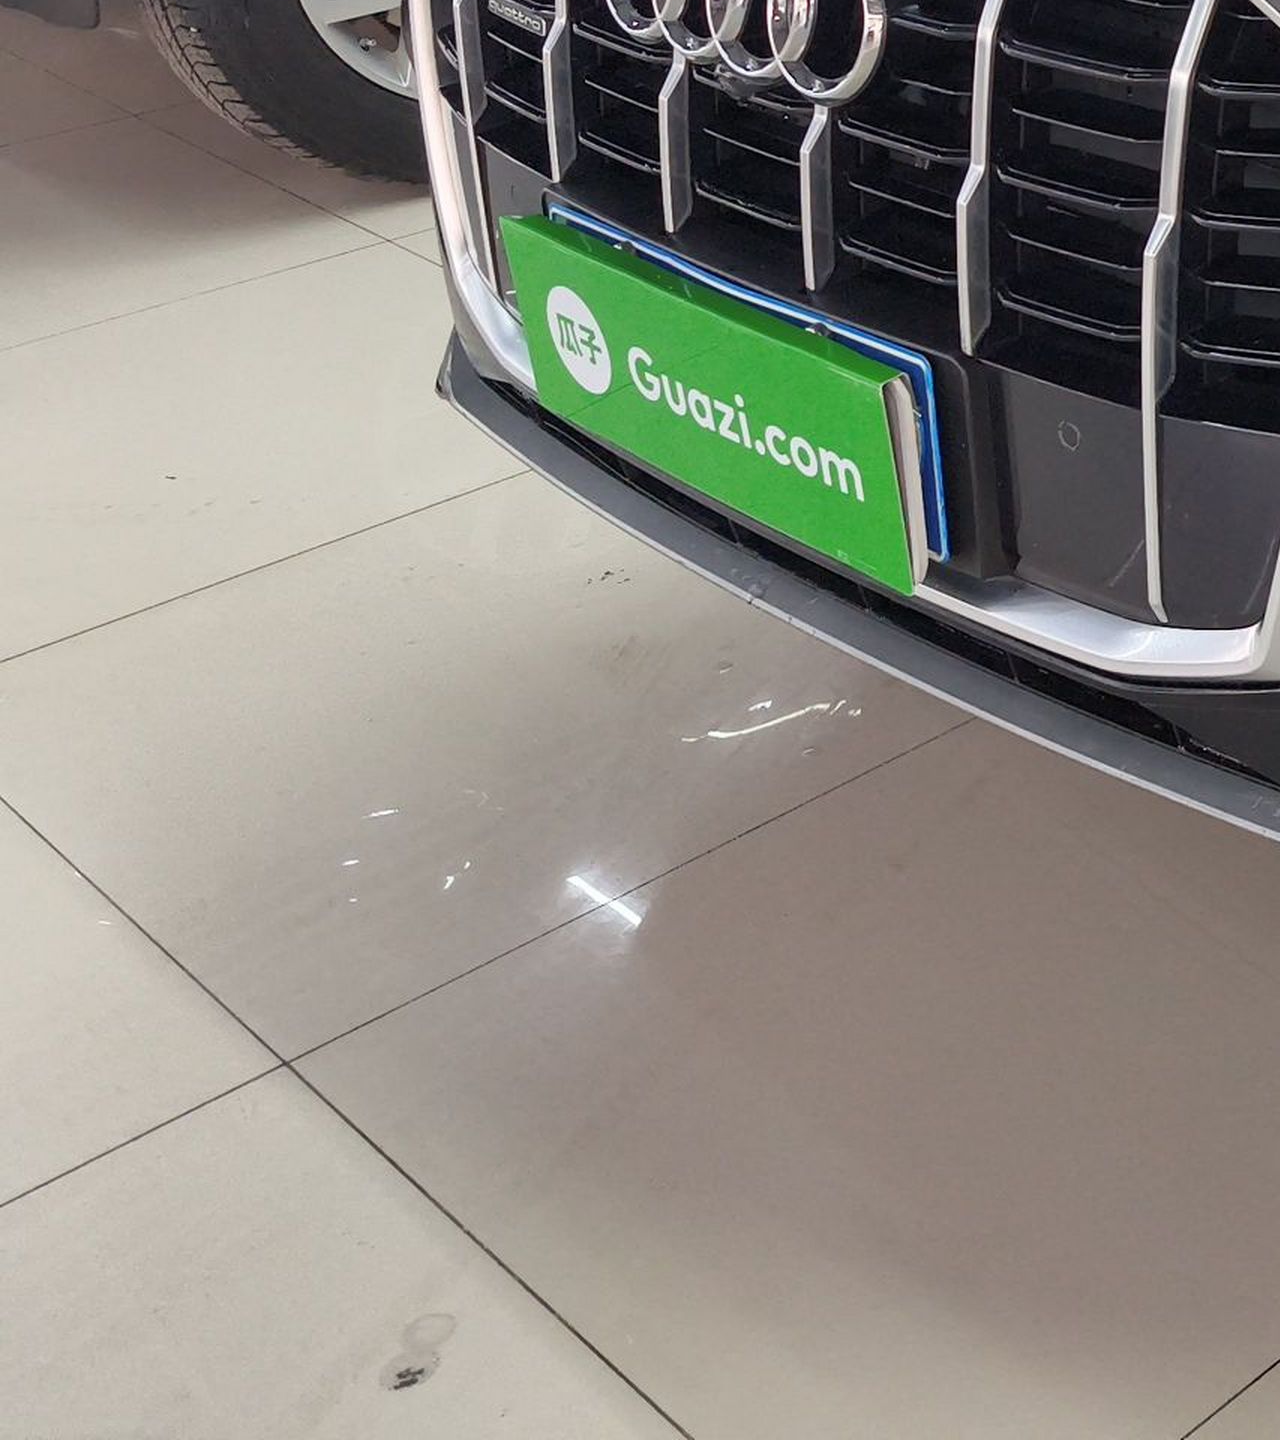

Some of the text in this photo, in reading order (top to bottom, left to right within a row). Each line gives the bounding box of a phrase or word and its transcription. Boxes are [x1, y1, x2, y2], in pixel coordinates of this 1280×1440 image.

[489, 0, 541, 32] quattro
[555, 313, 603, 366] 瓜子
[627, 346, 865, 502] Guazi.com
